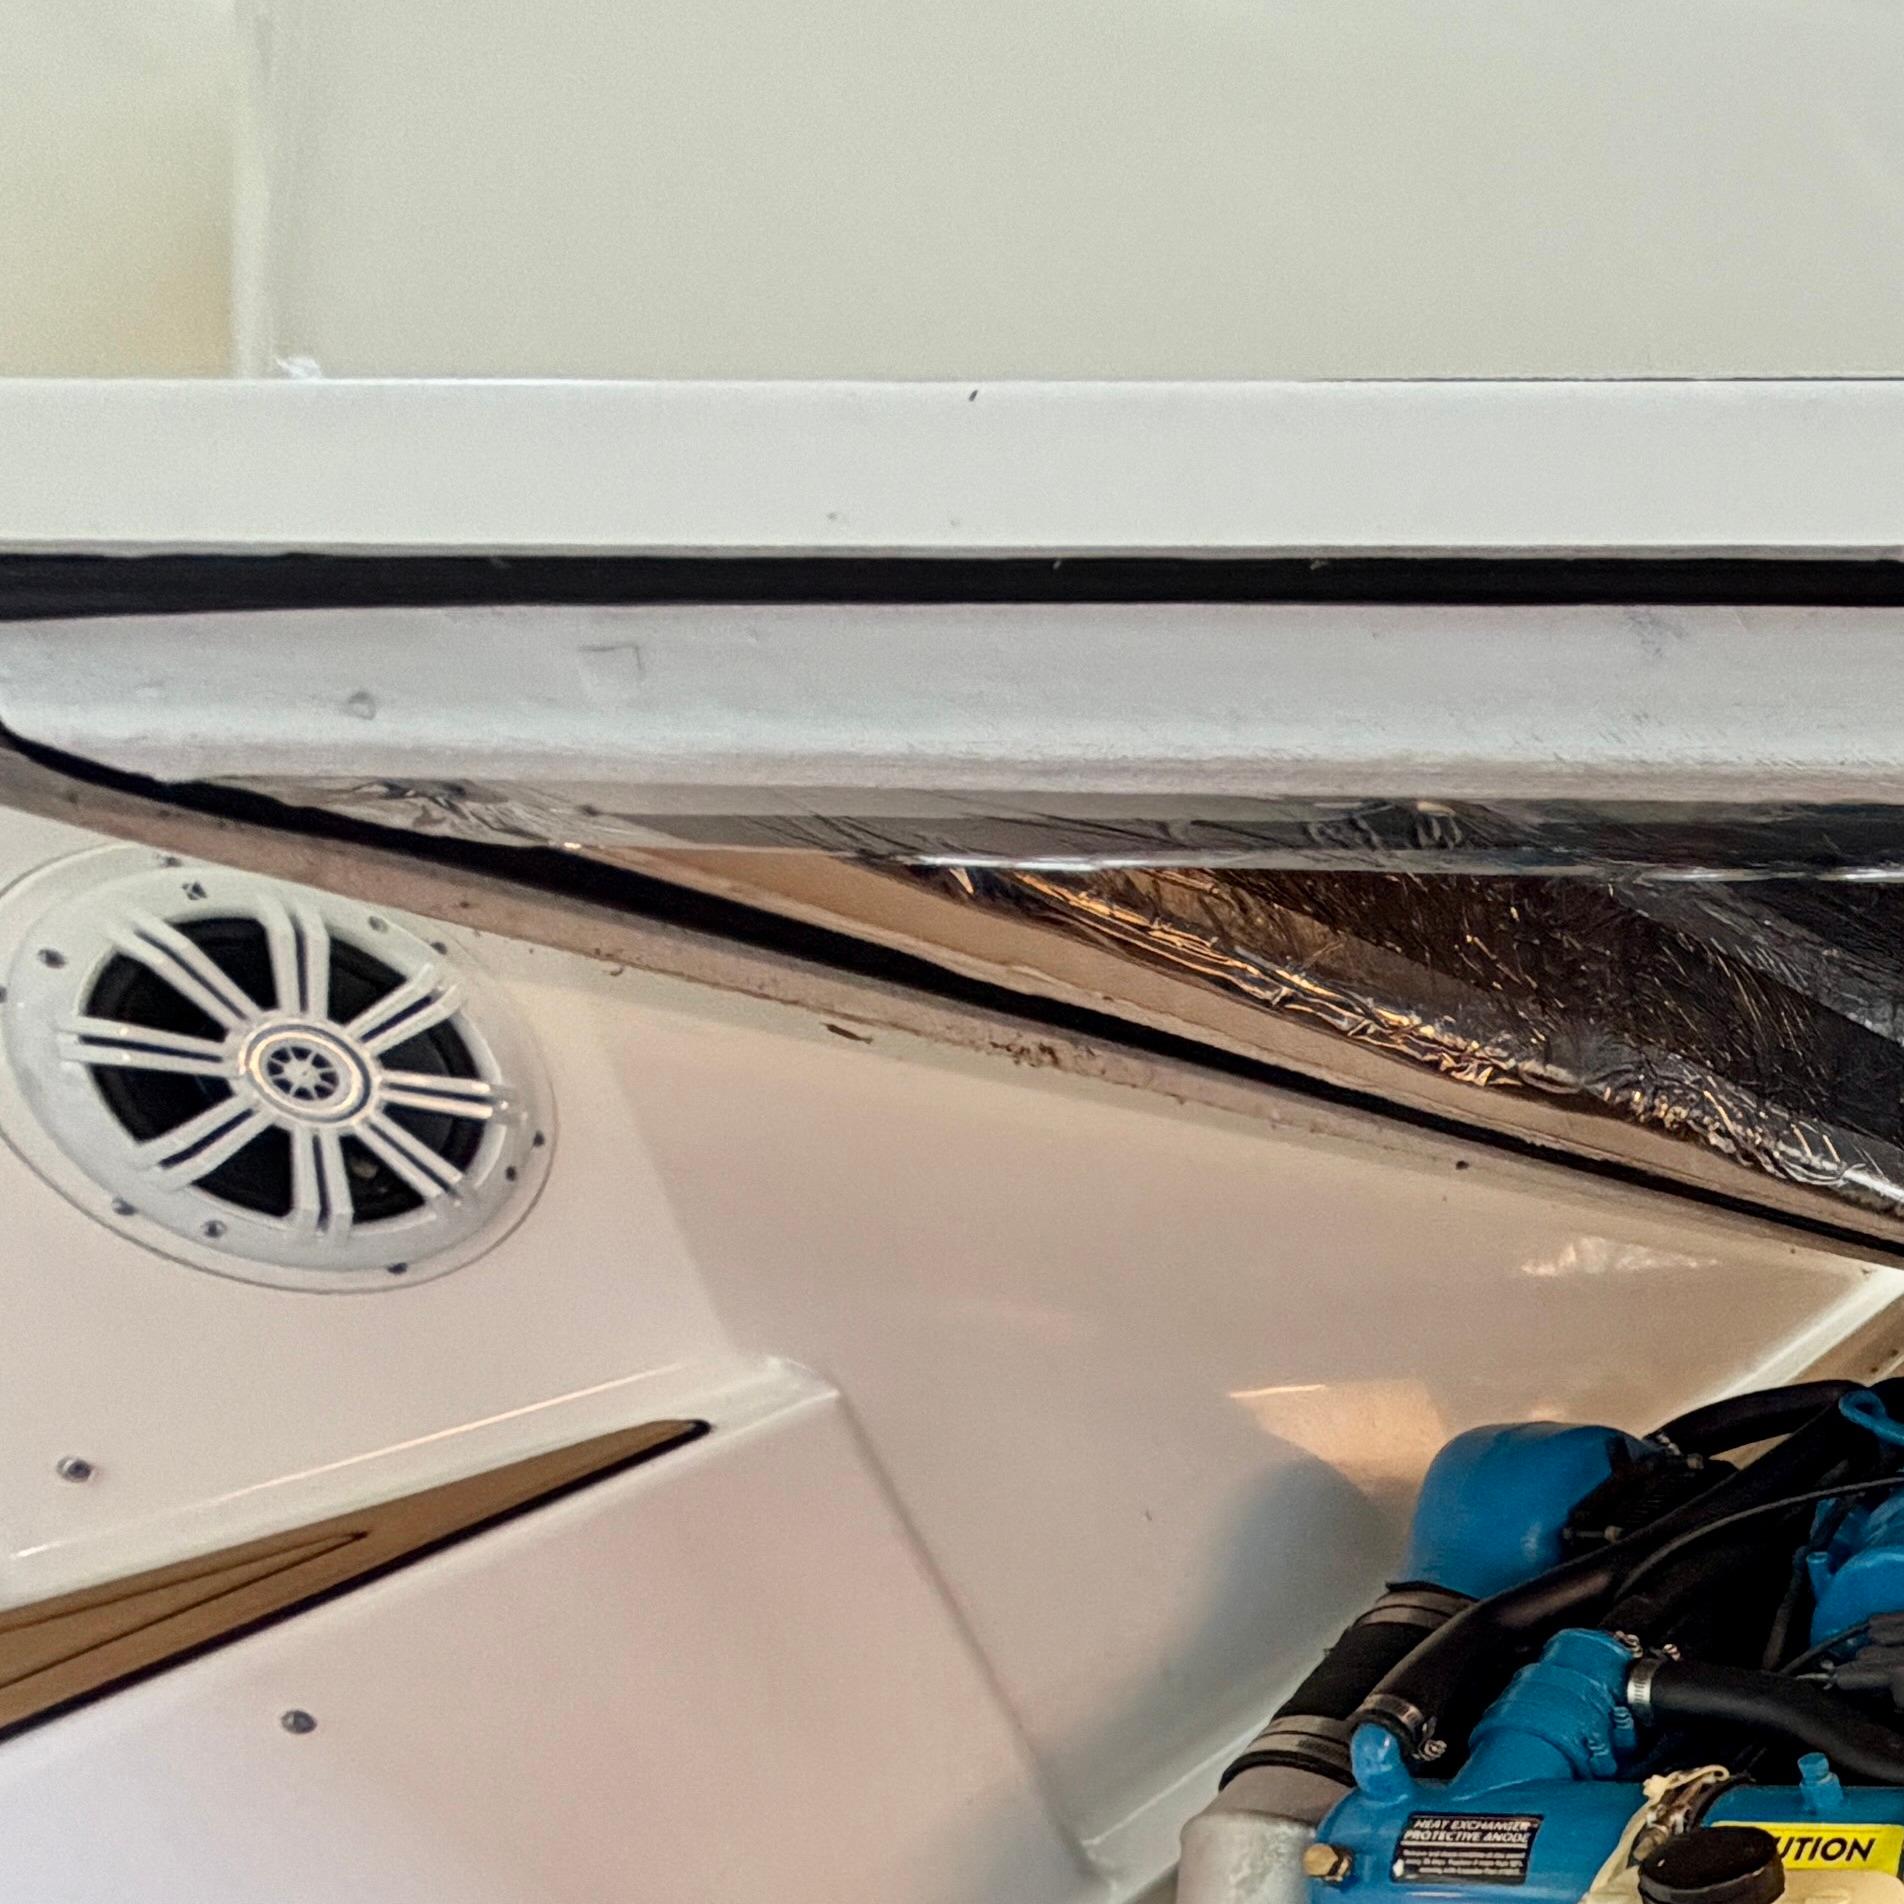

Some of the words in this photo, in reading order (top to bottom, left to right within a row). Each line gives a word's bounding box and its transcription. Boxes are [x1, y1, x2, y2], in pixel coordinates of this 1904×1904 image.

[1413, 1819, 1450, 1829] HEAT
[1450, 1820, 1531, 1831] EXCHANGER
[1403, 1830, 1481, 1841] PROTECTIVE
[1482, 1832, 1531, 1843] ANODE
